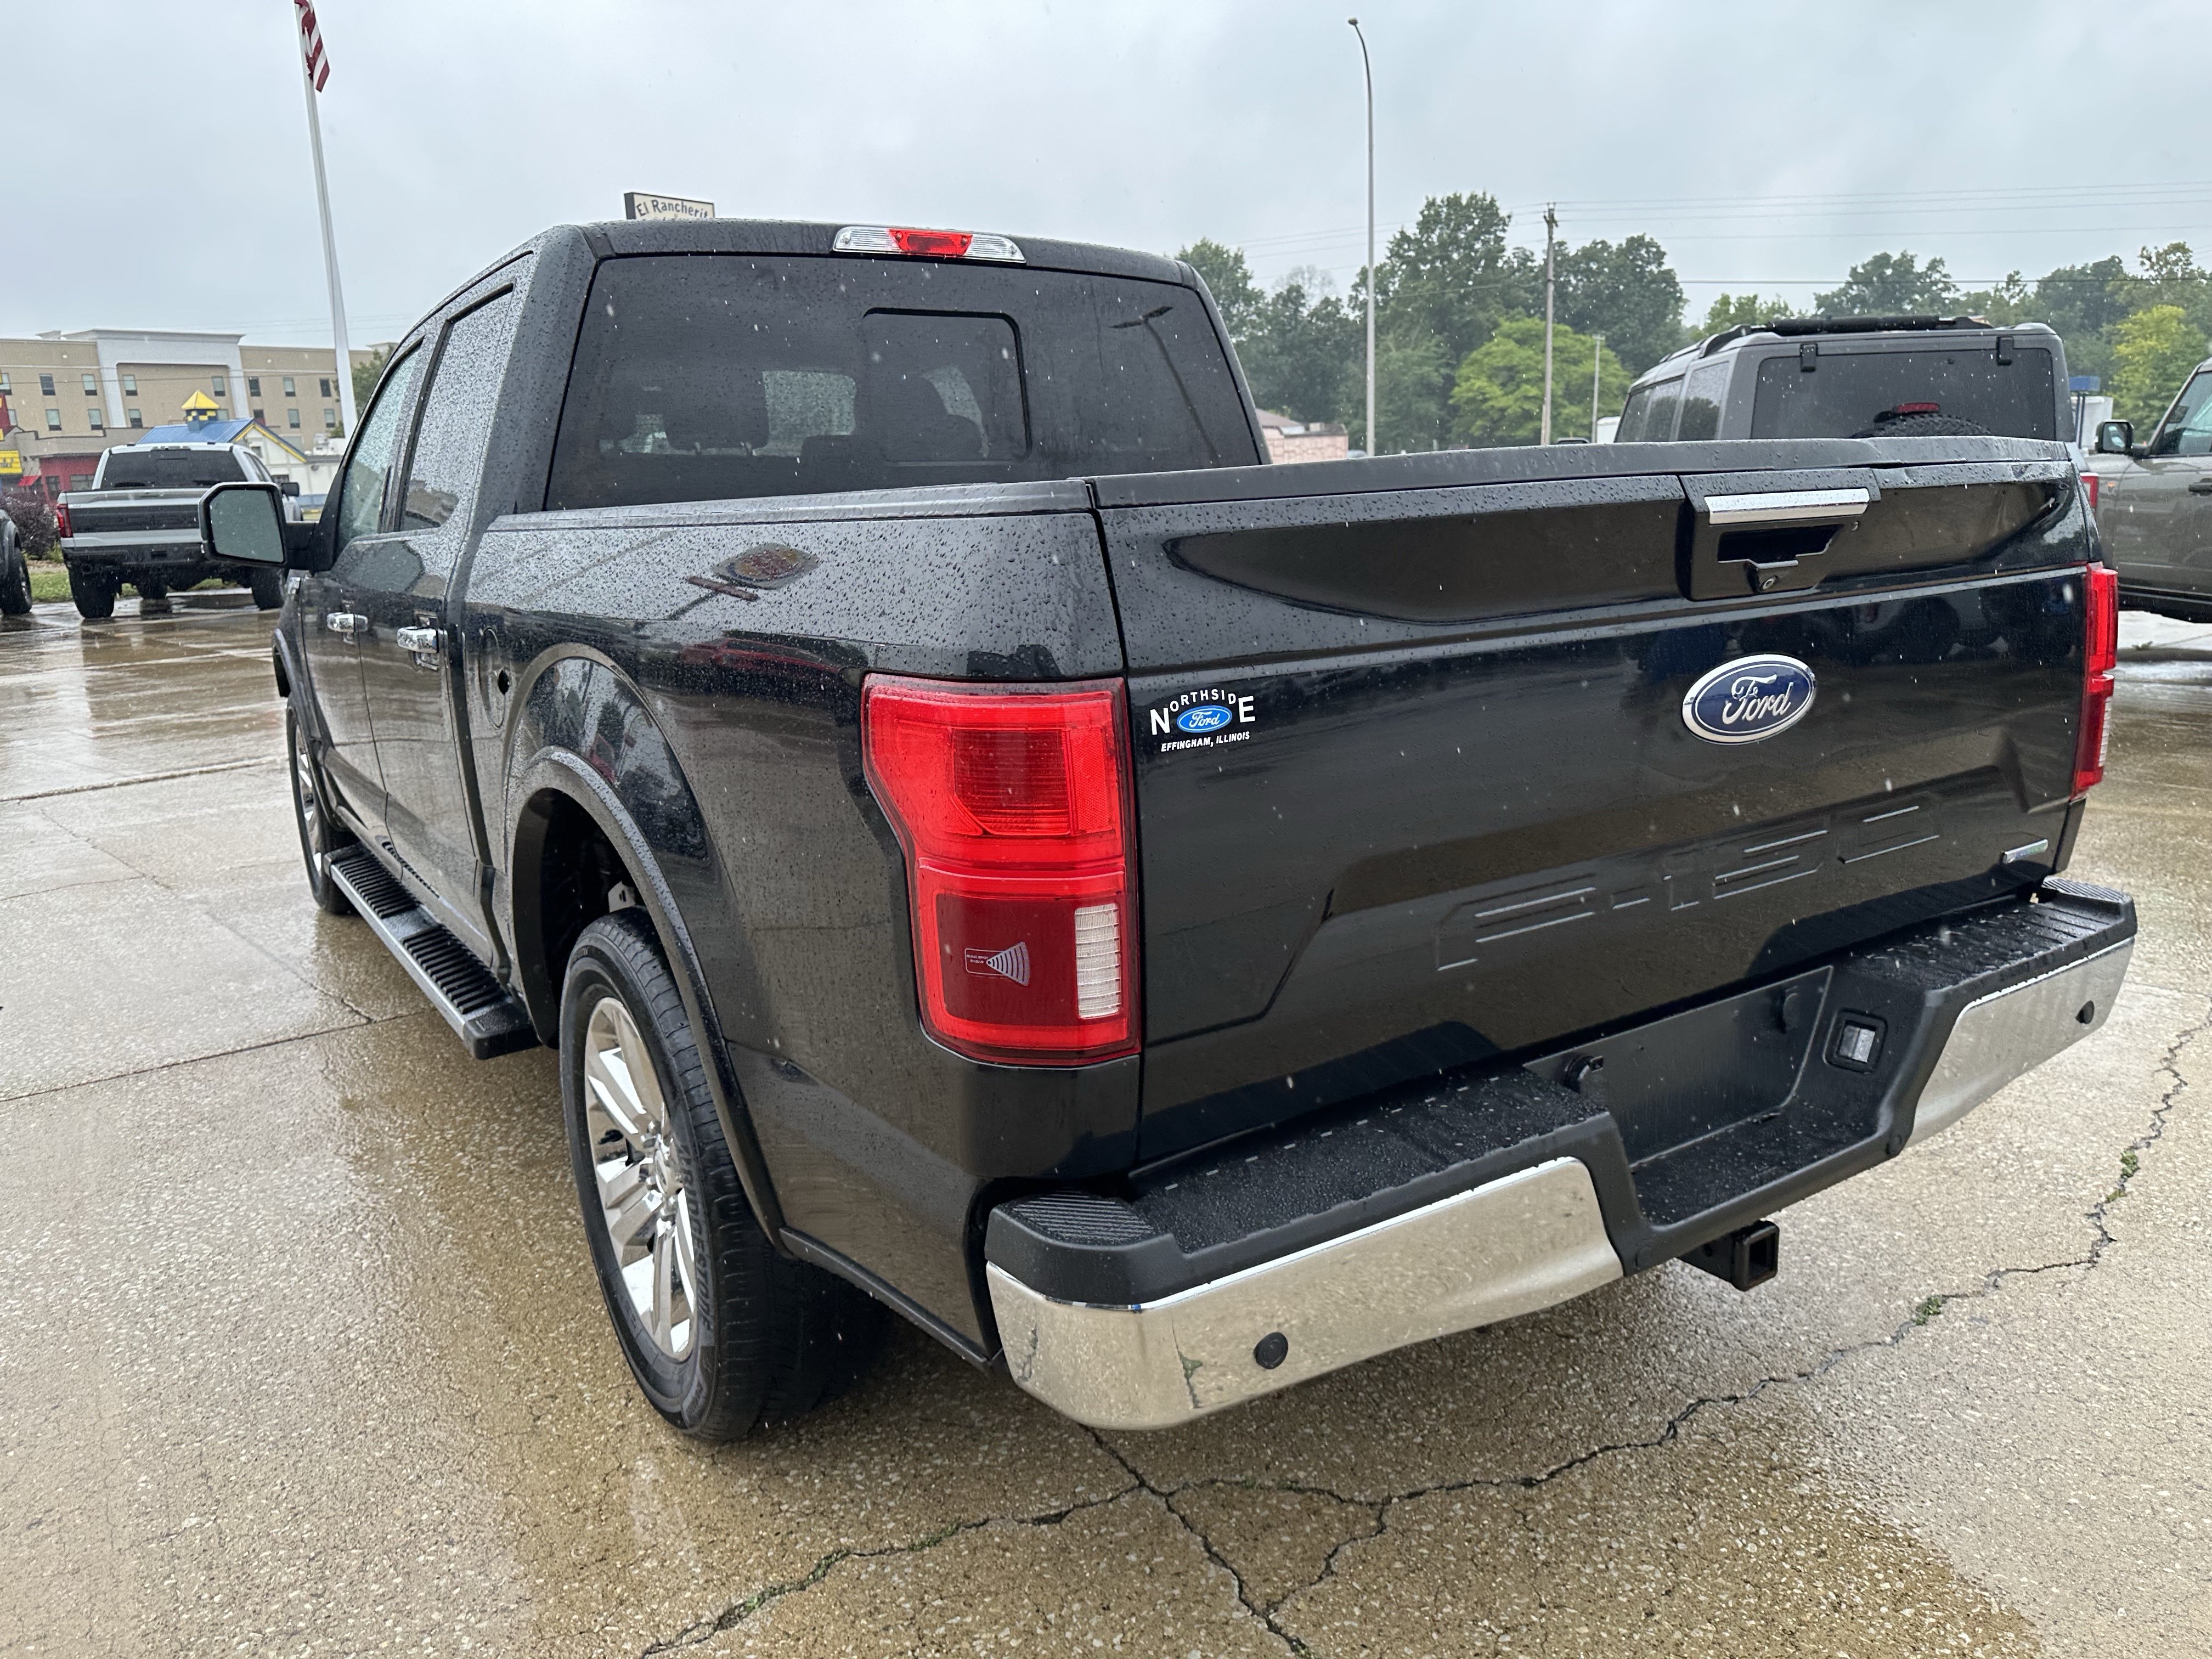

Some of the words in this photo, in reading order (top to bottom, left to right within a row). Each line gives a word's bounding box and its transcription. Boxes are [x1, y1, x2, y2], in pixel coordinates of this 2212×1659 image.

[636, 202, 650, 216] El
[1150, 689, 1256, 735] NORTHSIDE
[1722, 674, 1793, 725] Ford
[1189, 711, 1221, 728] Ford
[1161, 736, 1214, 752] EFFINGHAM,
[1216, 731, 1250, 744] ILLINOIS
[1436, 794, 1940, 970] F-150
